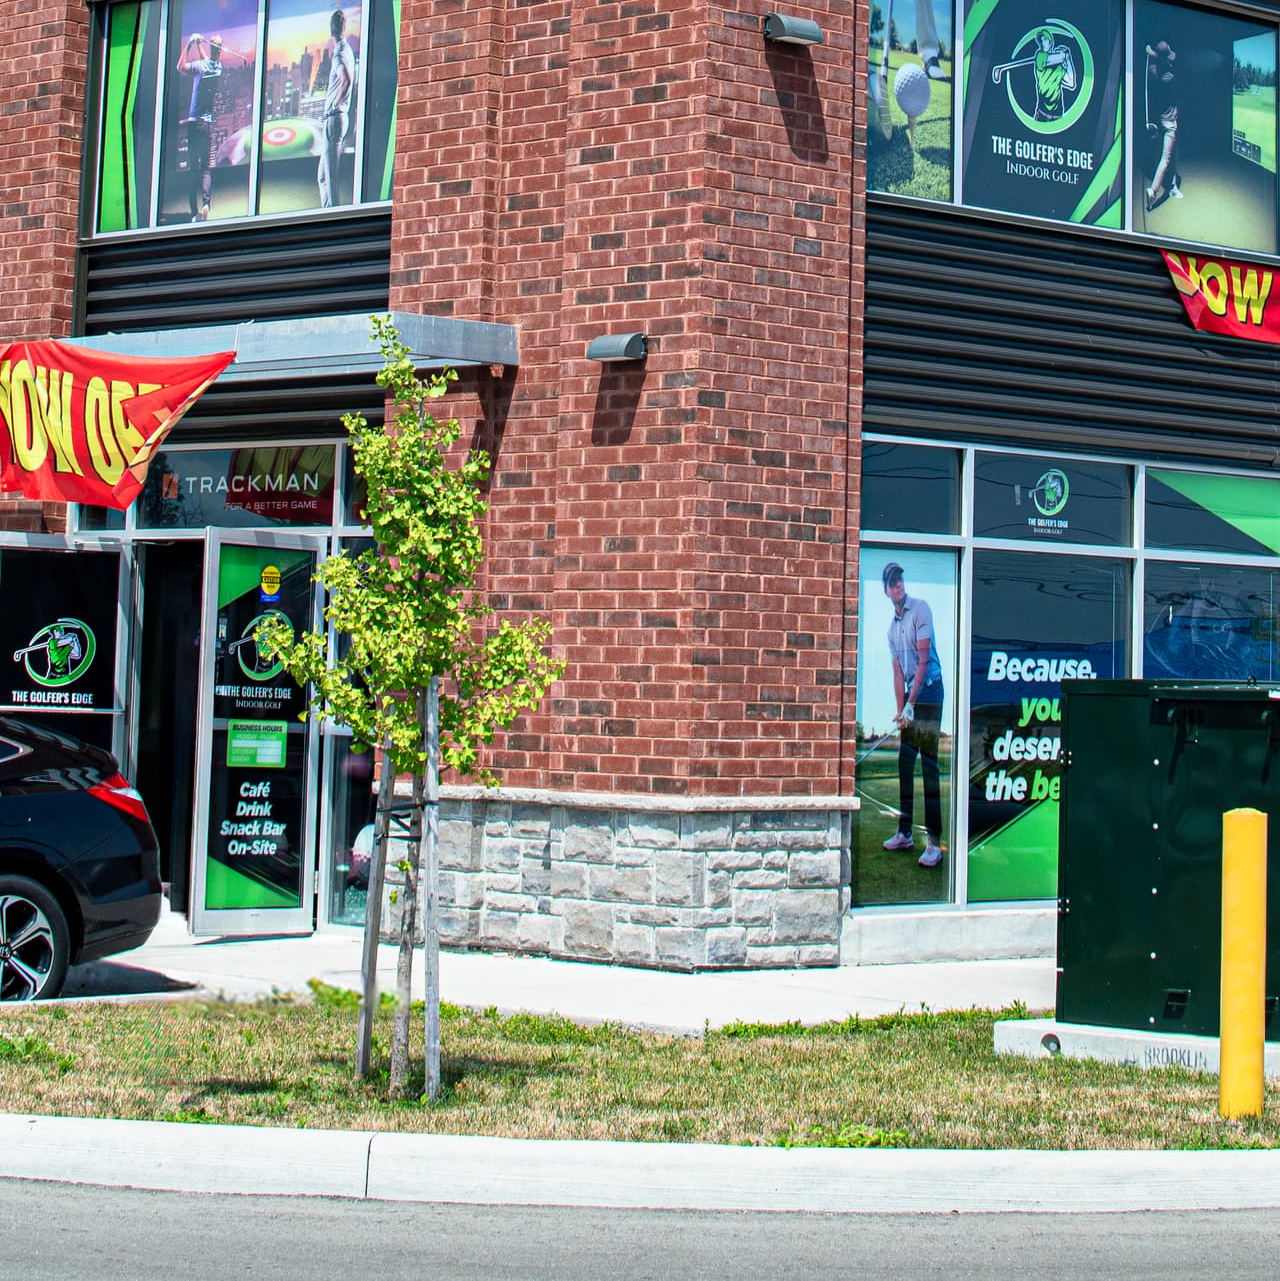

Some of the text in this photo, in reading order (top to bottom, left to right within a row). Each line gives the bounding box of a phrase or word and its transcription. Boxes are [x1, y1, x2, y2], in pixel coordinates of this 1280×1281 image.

[991, 135, 1094, 170] THE GOLFER'S EDGE
[1006, 160, 1079, 185] INDOOR GOLF
[185, 473, 319, 494] TRACKMAN
[225, 500, 318, 511] FOR A BETTER GAME
[12, 690, 93, 705] THE GOLFER'S EDGE
[229, 685, 240, 697] THE
[241, 686, 273, 698] GOLFER'S
[274, 688, 292, 699] EDGE
[236, 699, 282, 709] INDOOR GOLF
[993, 730, 1061, 761] deser
[240, 782, 271, 797] Café
[985, 770, 1060, 801] the be
[236, 801, 273, 816] Drink
[220, 820, 287, 835] Snack Bar
[228, 839, 277, 855] On-Site
